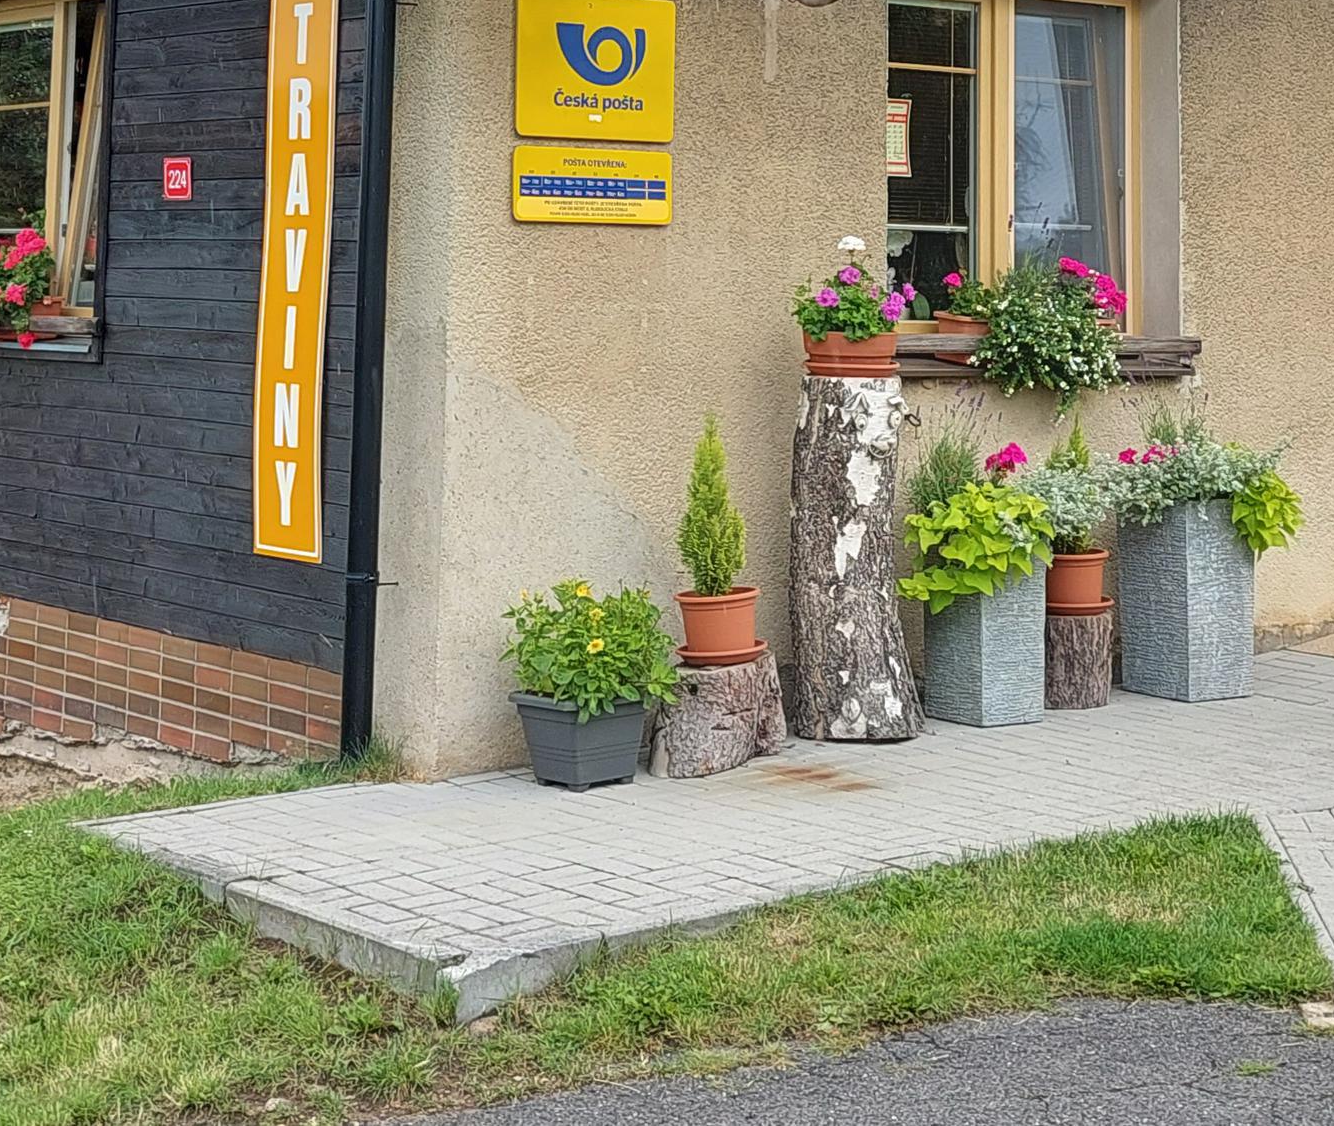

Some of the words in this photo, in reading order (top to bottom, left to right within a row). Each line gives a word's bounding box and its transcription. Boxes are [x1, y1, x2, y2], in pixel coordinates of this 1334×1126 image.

[554, 88, 598, 108] Česká
[602, 95, 643, 112] pošta
[563, 158, 586, 167] POŠTA
[168, 170, 186, 189] 224
